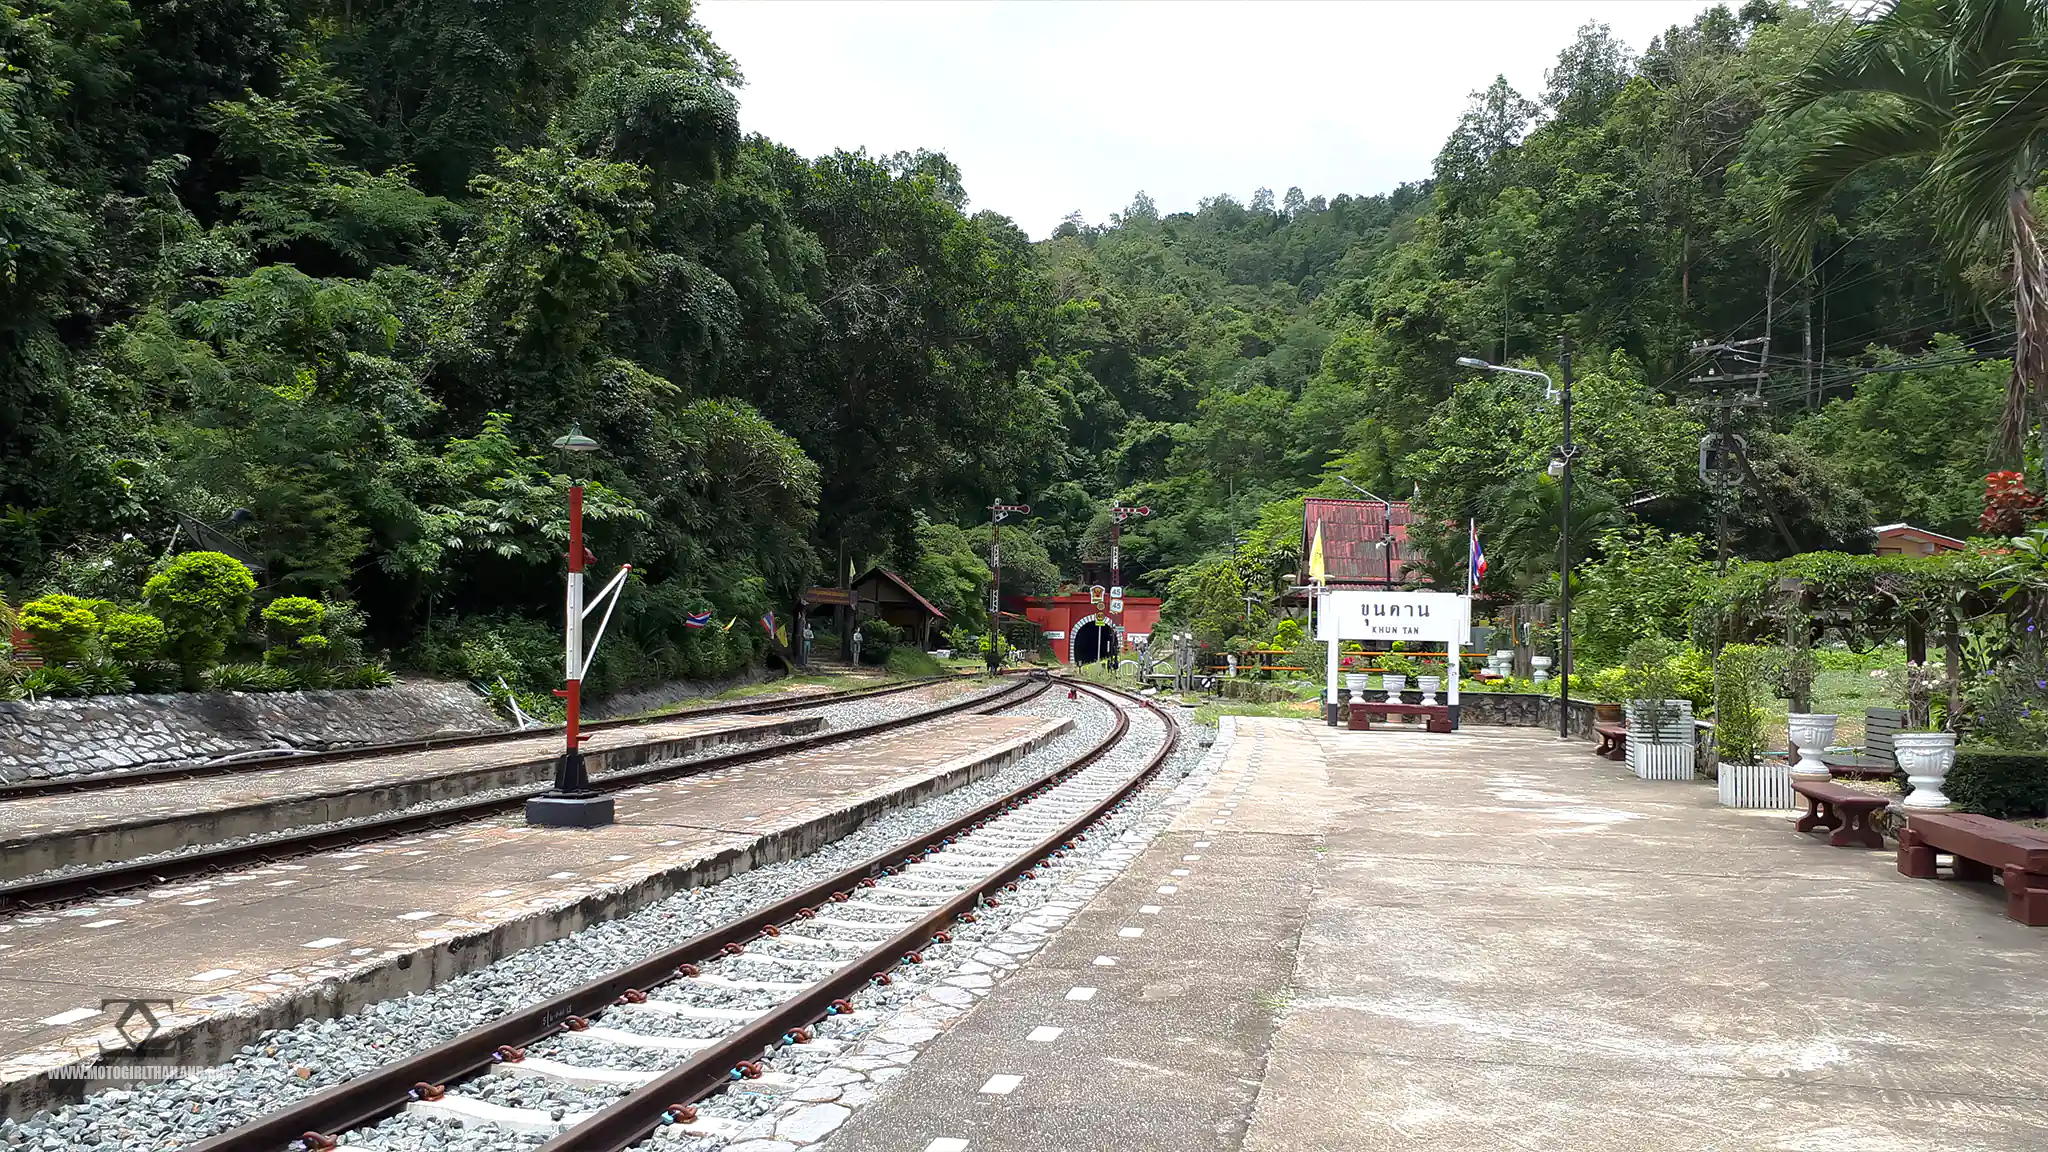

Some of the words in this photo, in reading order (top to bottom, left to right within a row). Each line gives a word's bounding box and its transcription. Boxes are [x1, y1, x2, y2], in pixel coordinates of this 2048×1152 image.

[1112, 588, 1121, 596] 45
[1112, 602, 1121, 610] 45
[1371, 626, 1398, 634] KHUN
[1402, 626, 1419, 635] TAN
